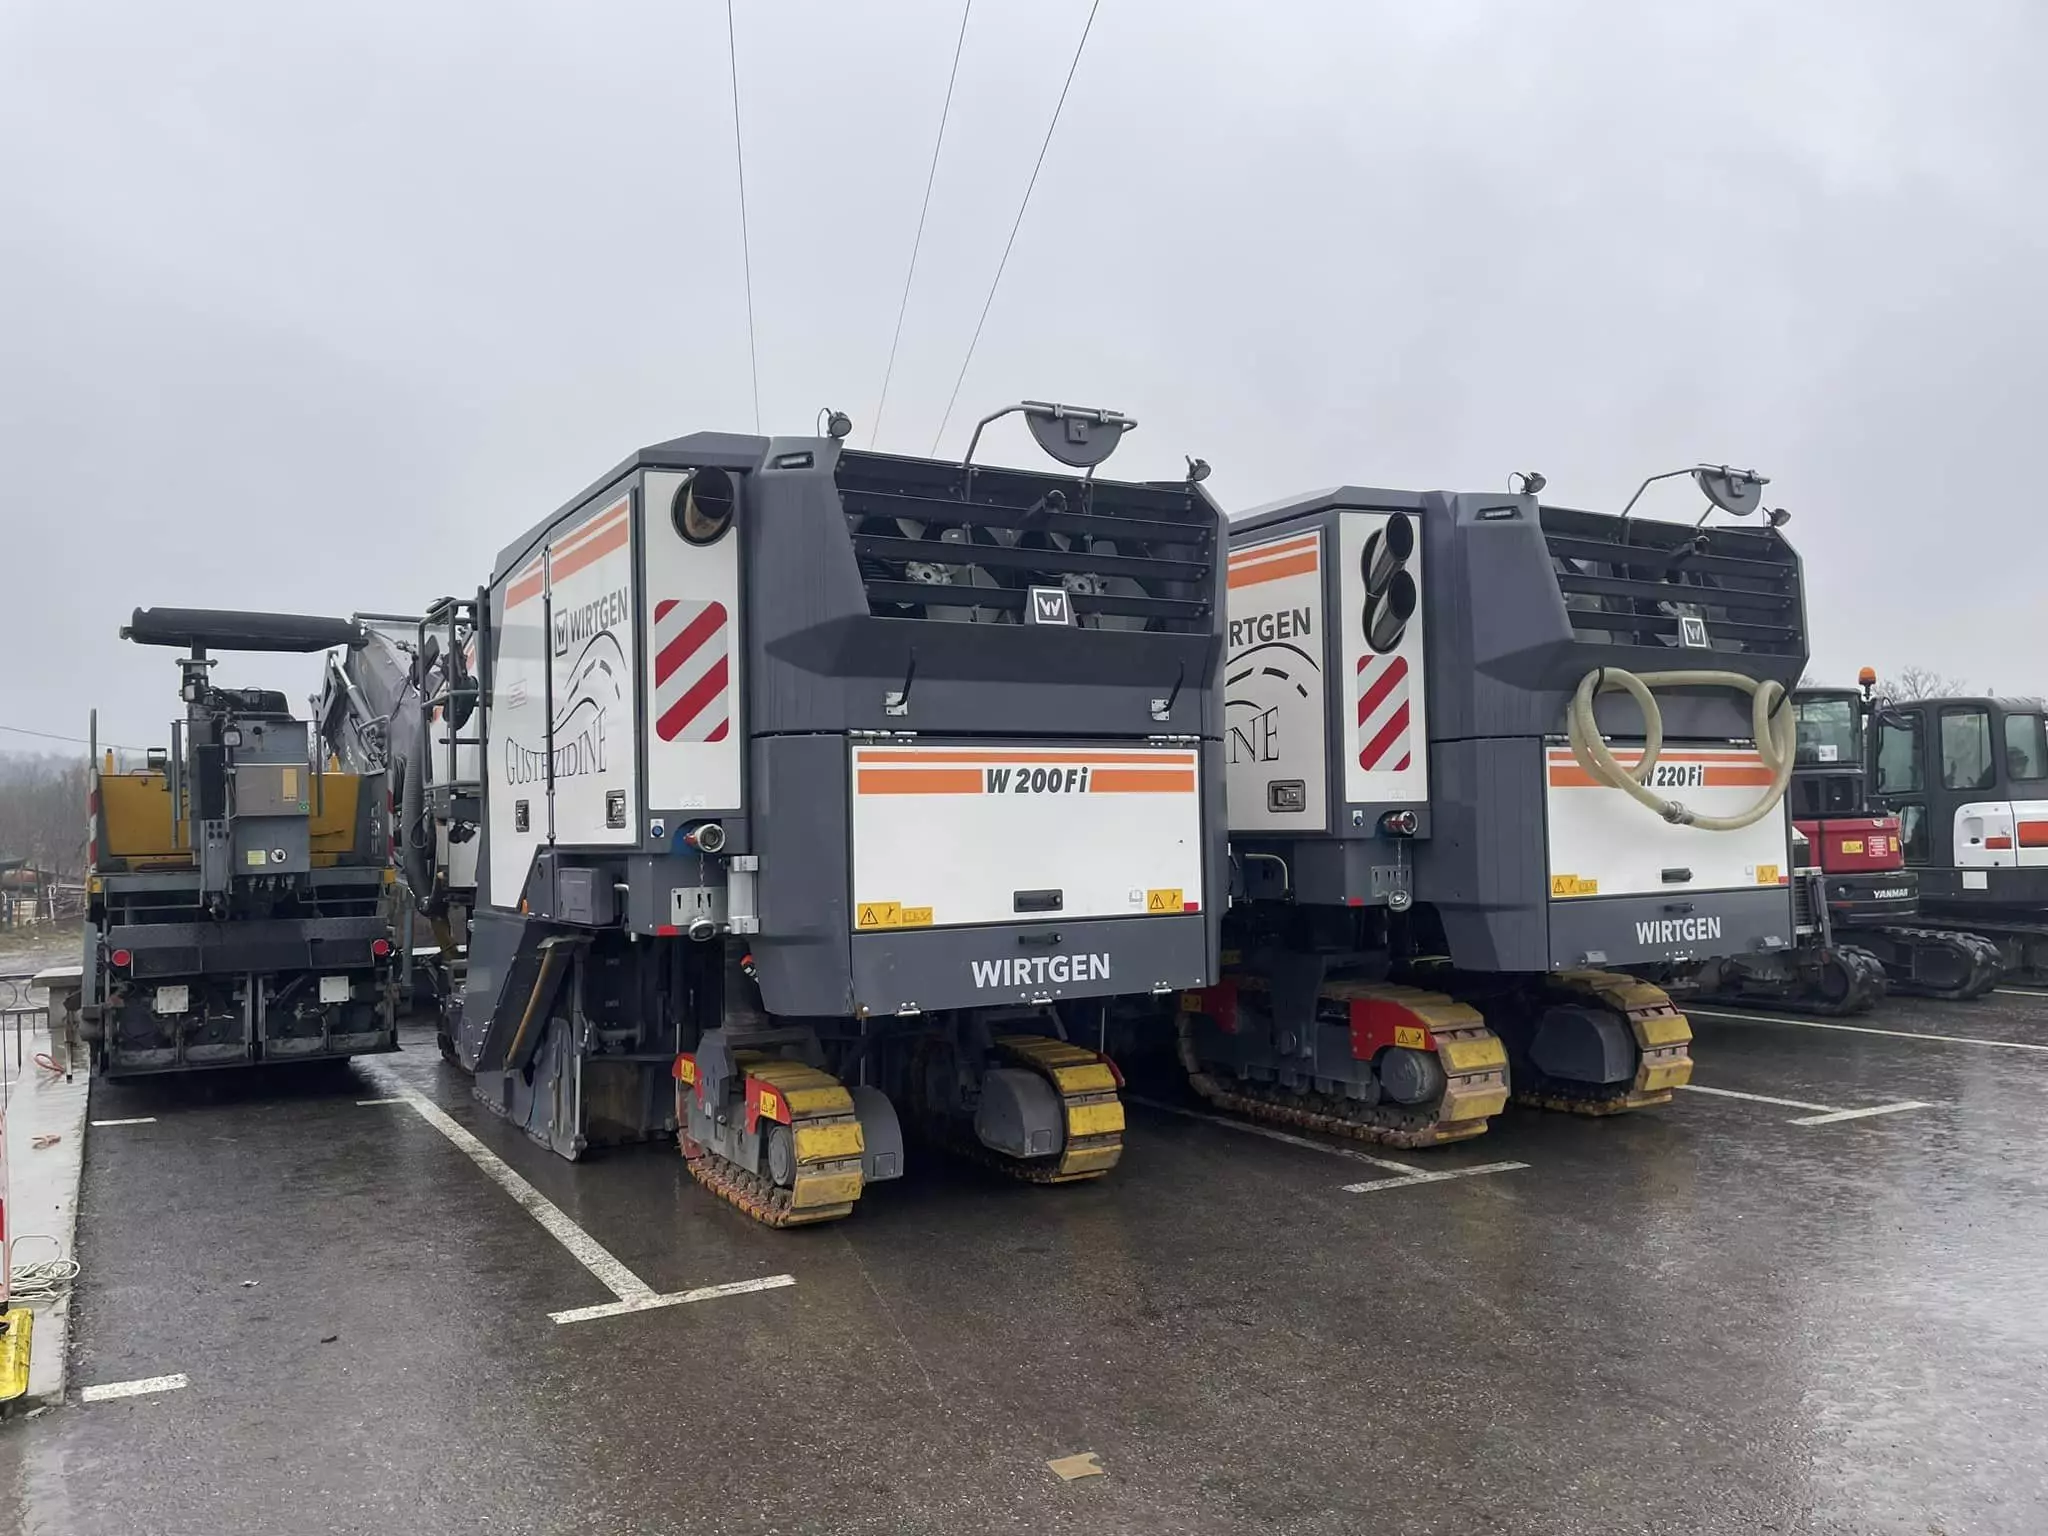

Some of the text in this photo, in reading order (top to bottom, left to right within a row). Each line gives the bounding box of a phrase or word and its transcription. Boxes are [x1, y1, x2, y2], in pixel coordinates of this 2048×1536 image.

[570, 587, 628, 643] WIRTGEN
[1229, 607, 1311, 647] RTGEN
[986, 768, 1011, 793] W
[1635, 916, 1721, 944] WIRTGEN
[971, 952, 1110, 988] WIRTGEN
